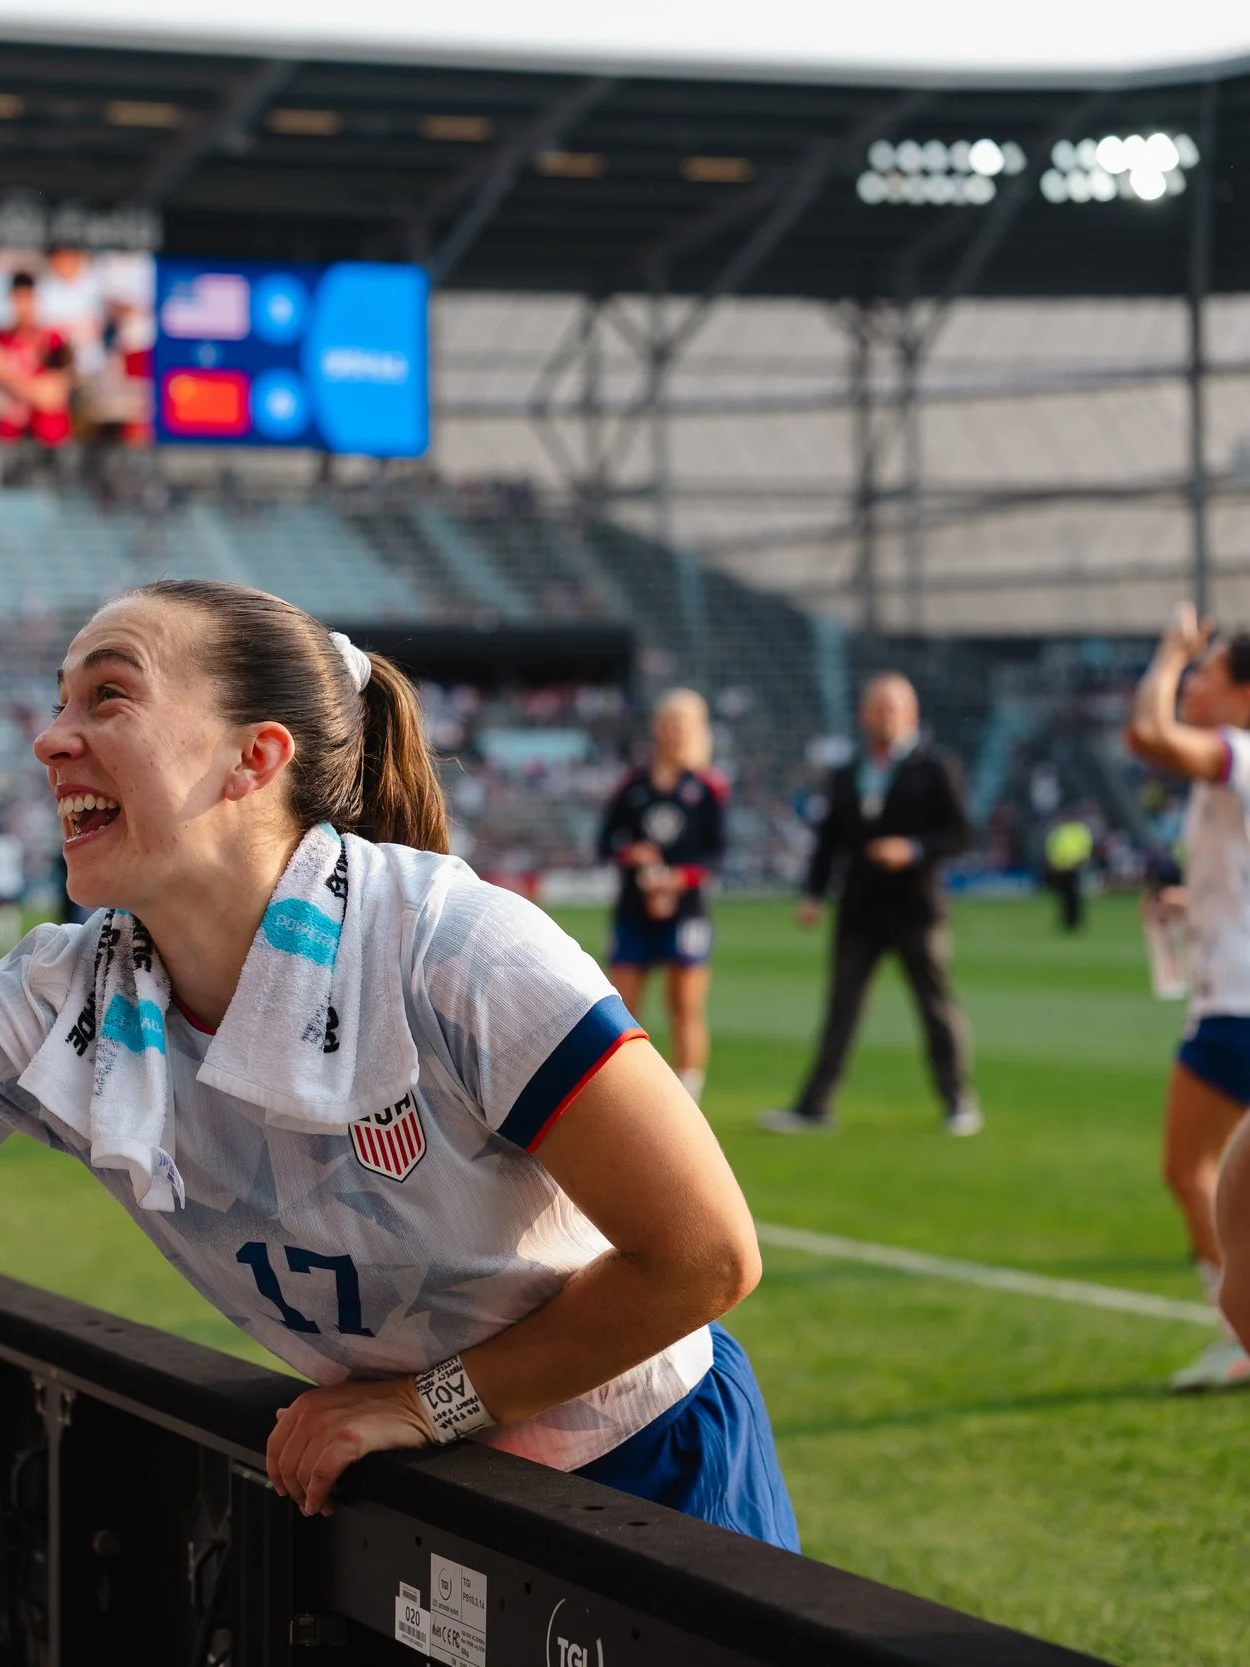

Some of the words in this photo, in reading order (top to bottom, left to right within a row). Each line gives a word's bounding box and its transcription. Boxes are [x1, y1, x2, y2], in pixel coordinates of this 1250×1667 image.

[236, 1241, 375, 1338] 17
[438, 1411, 466, 1430] FEAR
[405, 1606, 421, 1627] 020
[557, 1636, 588, 1667] TGI
